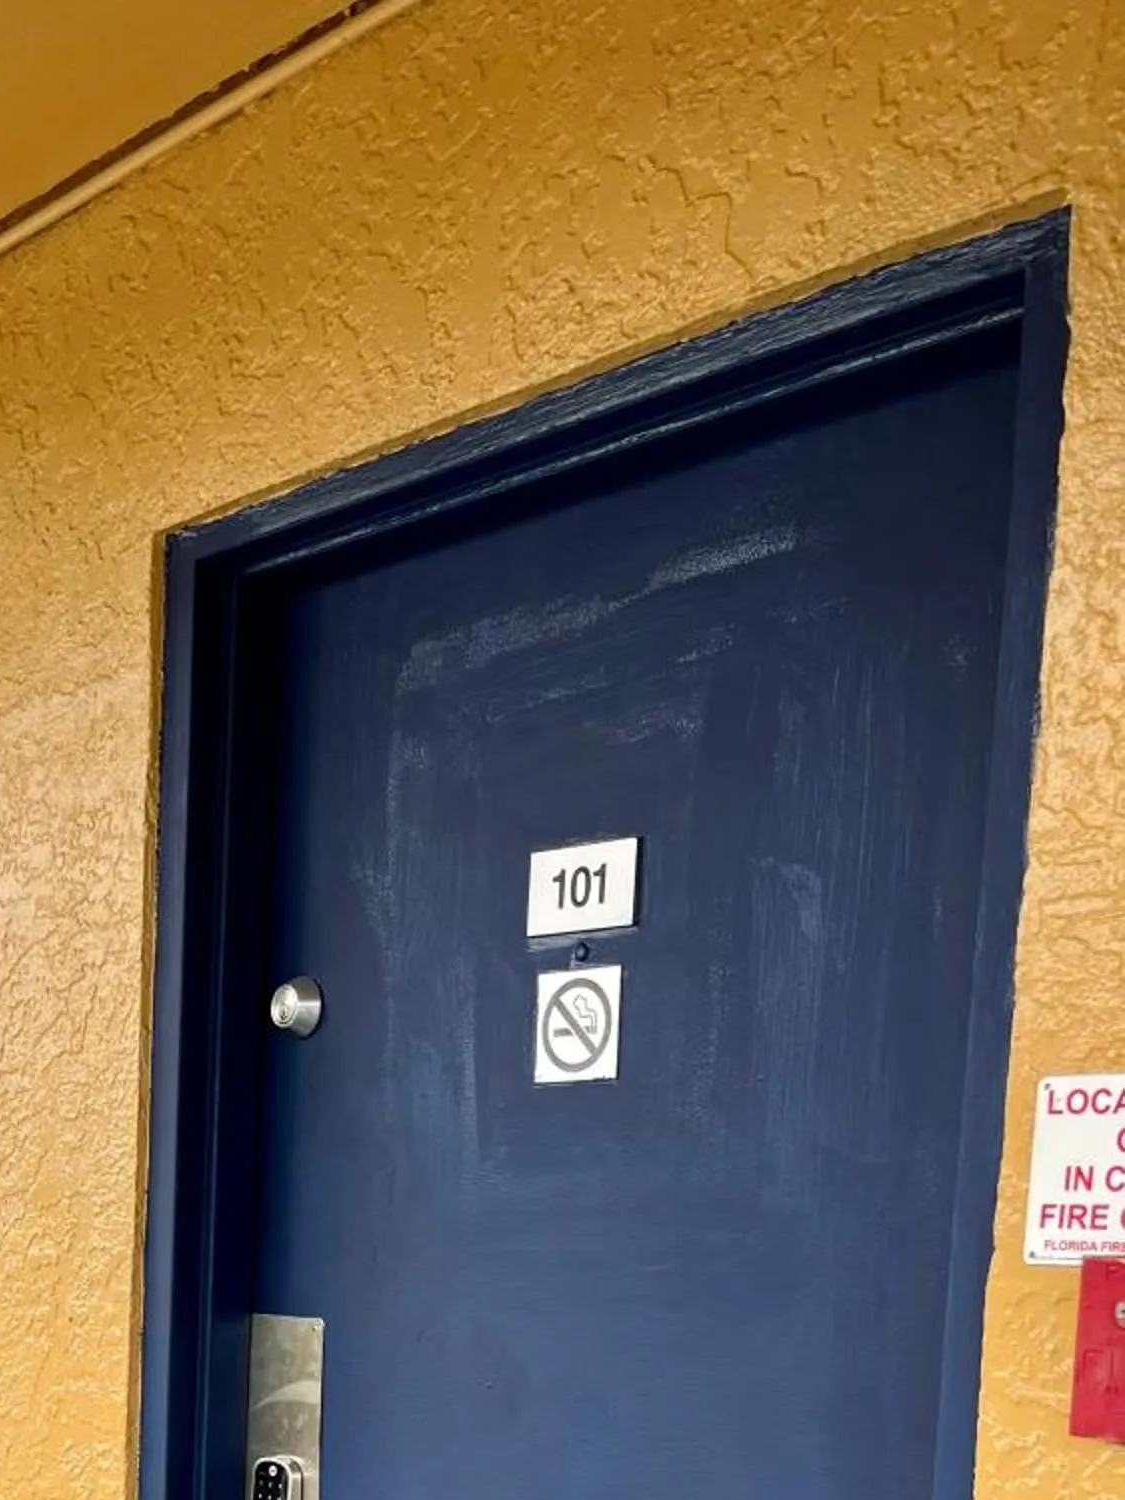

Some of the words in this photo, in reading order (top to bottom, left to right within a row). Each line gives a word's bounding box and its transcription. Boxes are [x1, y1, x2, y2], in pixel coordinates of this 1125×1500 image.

[552, 863, 607, 909] 101
[1064, 1165, 1094, 1192] IN
[1039, 1204, 1110, 1230] FIRE
[1044, 1239, 1097, 1252] FLORIDA
